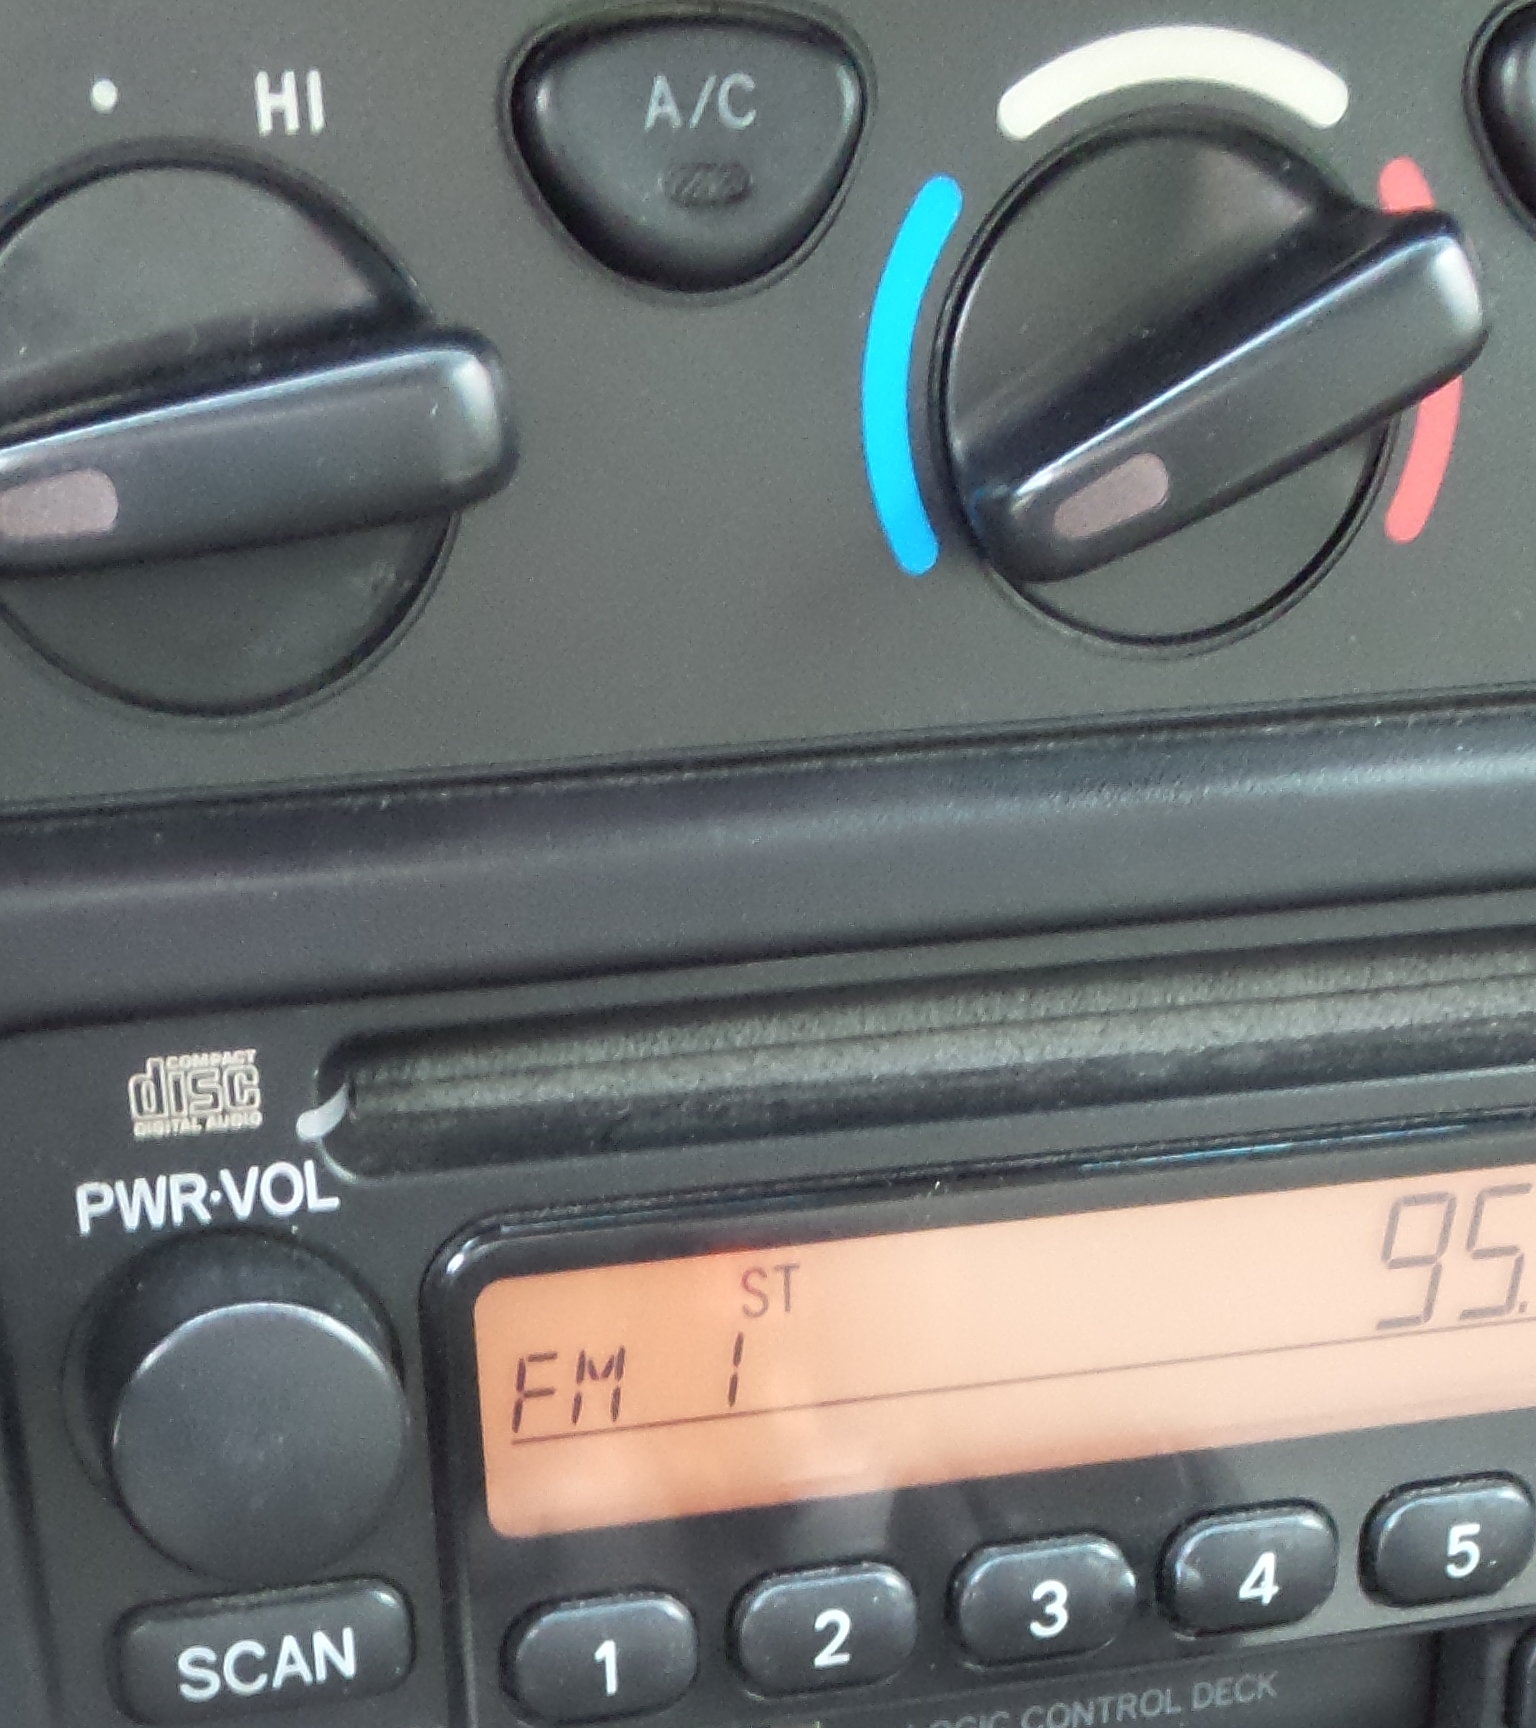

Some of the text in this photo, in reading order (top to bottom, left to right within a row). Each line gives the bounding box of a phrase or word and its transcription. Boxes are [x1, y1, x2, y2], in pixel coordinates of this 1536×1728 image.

[254, 69, 325, 136] HI
[643, 73, 758, 131] A/C
[165, 1048, 257, 1069] COMPACT
[133, 1111, 263, 1139] DIGITAL AUDIO
[739, 1262, 801, 1320] ST
[511, 1347, 626, 1433] FM
[1238, 1551, 1280, 1605] 4
[1446, 1522, 1482, 1578] 5
[1029, 1579, 1069, 1638] 3
[177, 1626, 357, 1702] SCAN
[813, 1608, 852, 1668] 2
[593, 1639, 619, 1696] 1
[1191, 1672, 1277, 1712] DECK
